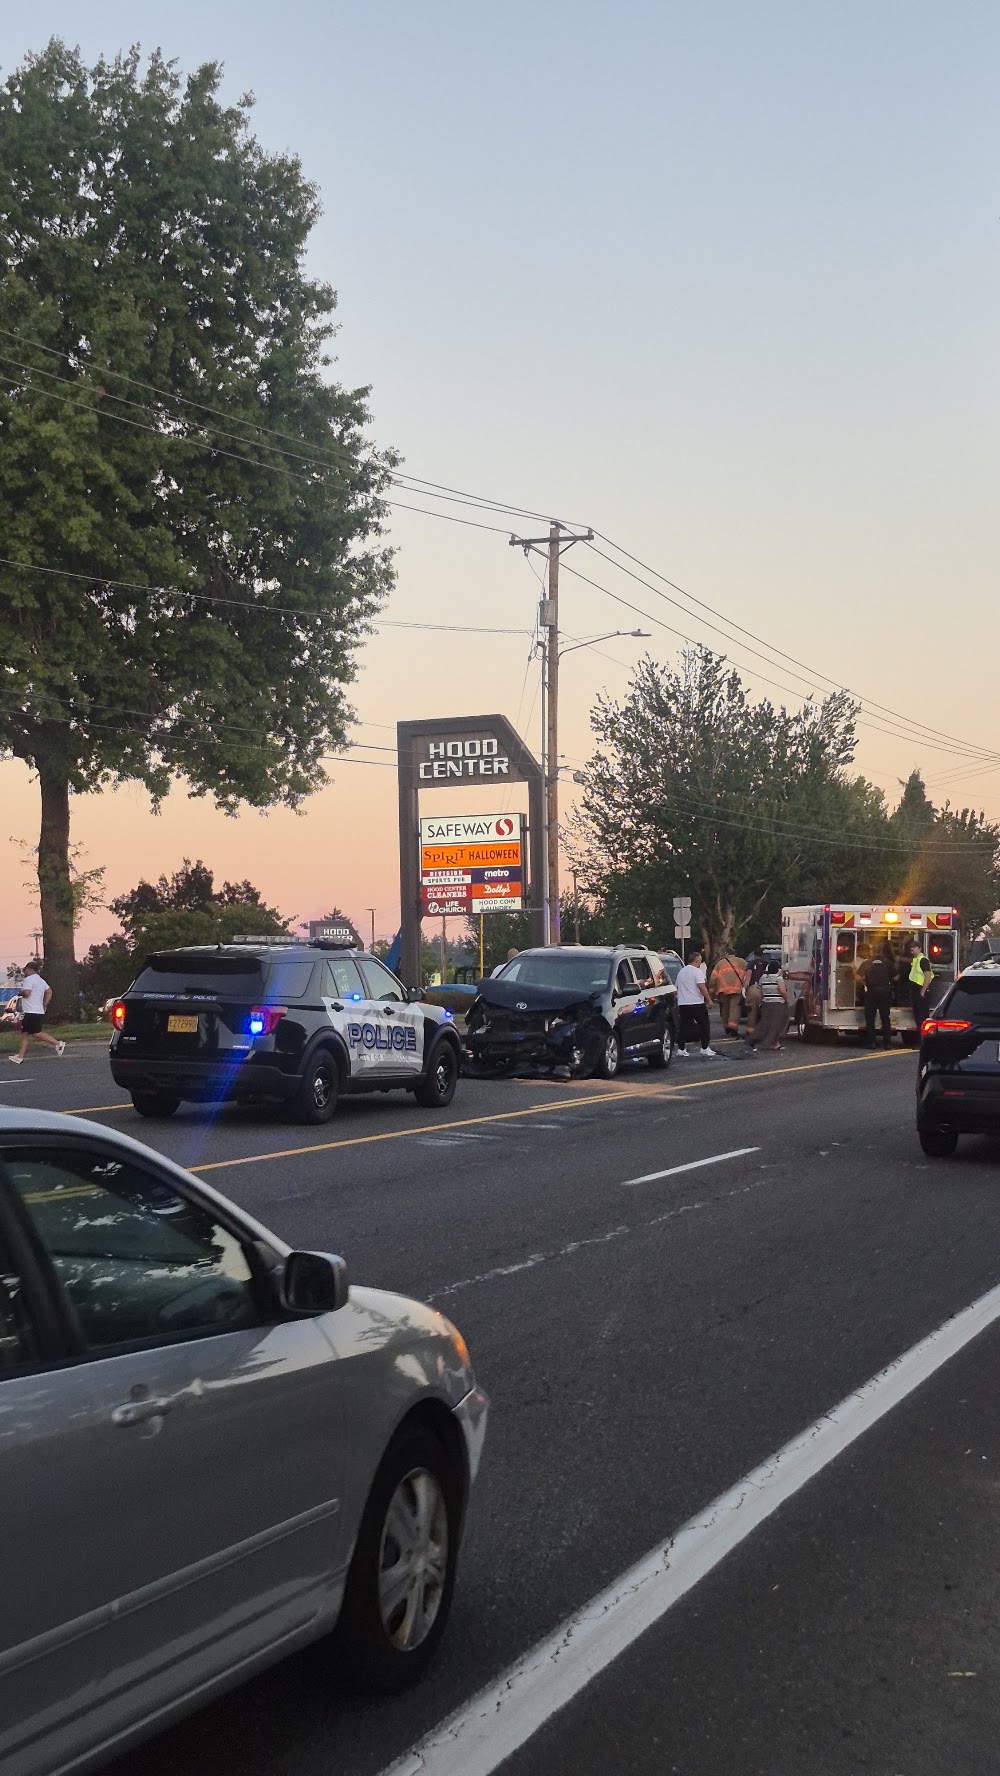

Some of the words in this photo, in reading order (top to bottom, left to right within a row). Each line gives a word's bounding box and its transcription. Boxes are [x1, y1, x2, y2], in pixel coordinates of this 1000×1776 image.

[429, 738, 498, 759] HOOD
[419, 757, 509, 779] CENTER
[427, 821, 493, 838] SAFEWAY
[424, 848, 466, 864] SPIRIT
[469, 849, 519, 861] HALLOWEEN
[484, 869, 510, 878] metro
[427, 891, 467, 899] CLEANERS
[438, 906, 467, 914] CHURCH
[445, 900, 460, 908] LIFE
[323, 928, 350, 936] HOOD
[347, 1022, 417, 1051] POLICE
